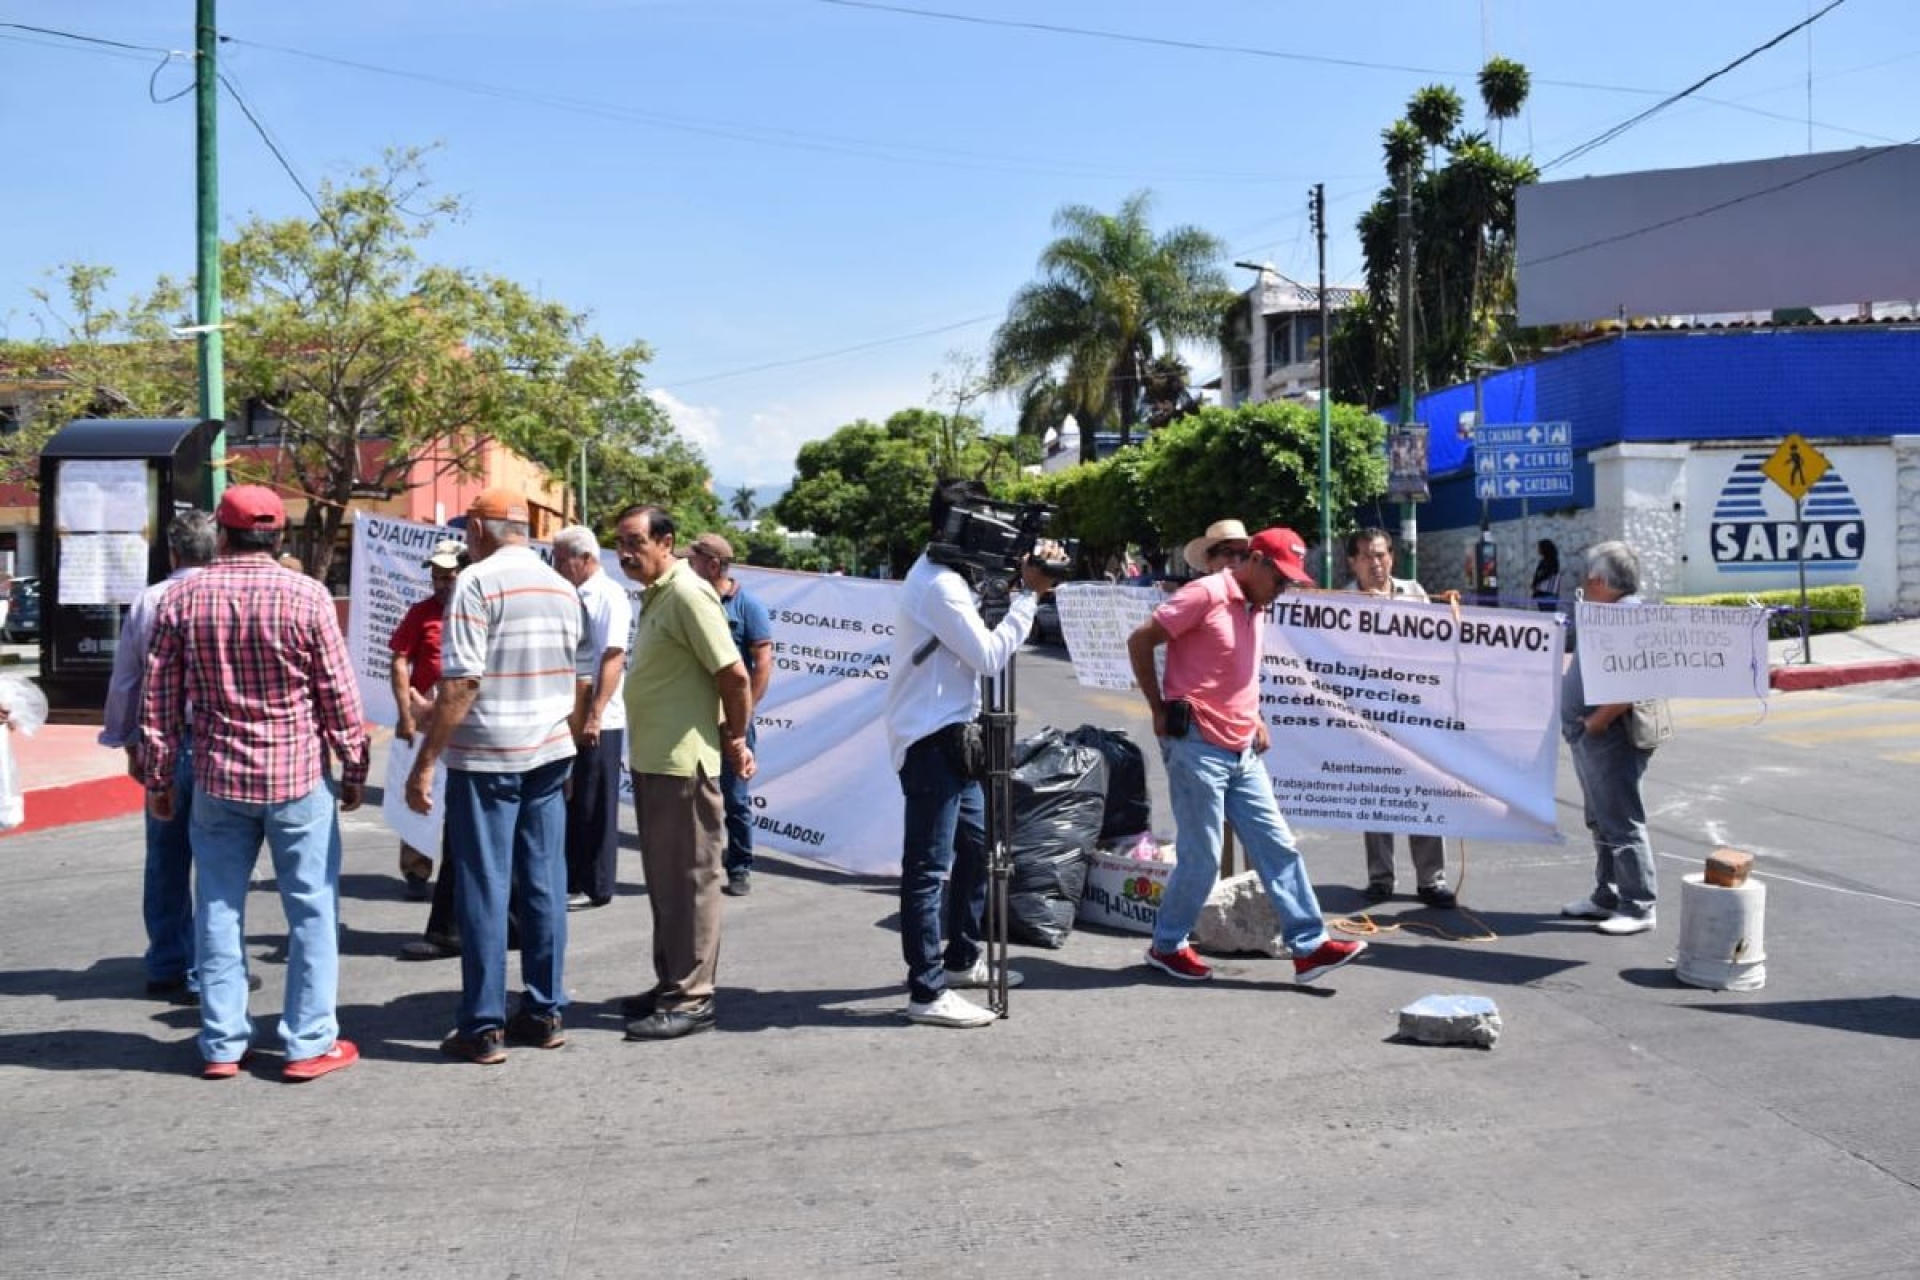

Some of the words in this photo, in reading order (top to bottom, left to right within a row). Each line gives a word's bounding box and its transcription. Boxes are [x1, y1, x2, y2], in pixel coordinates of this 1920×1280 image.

[1524, 452, 1569, 467] CENTRO
[367, 518, 463, 550] CUAUHTÉ
[1715, 523, 1860, 562] SAPAC
[781, 610, 867, 634] SOCIALES,
[1359, 610, 1453, 641] BLANCO
[1459, 621, 1550, 652] BRAVO:
[806, 662, 825, 675] YA
[1306, 657, 1441, 686] trabajadores
[1602, 649, 1726, 673] audiencia
[1272, 674, 1306, 686] nos
[1311, 679, 1422, 705] desprecies
[1271, 714, 1320, 727] seas
[1361, 708, 1466, 731] audiencia
[1273, 776, 1344, 791] Trabajadores
[1346, 781, 1400, 794] Jubilados
[1404, 786, 1411, 797] y
[1356, 810, 1369, 820] de
[1380, 799, 1419, 809] Estado
[1421, 801, 1429, 811] y
